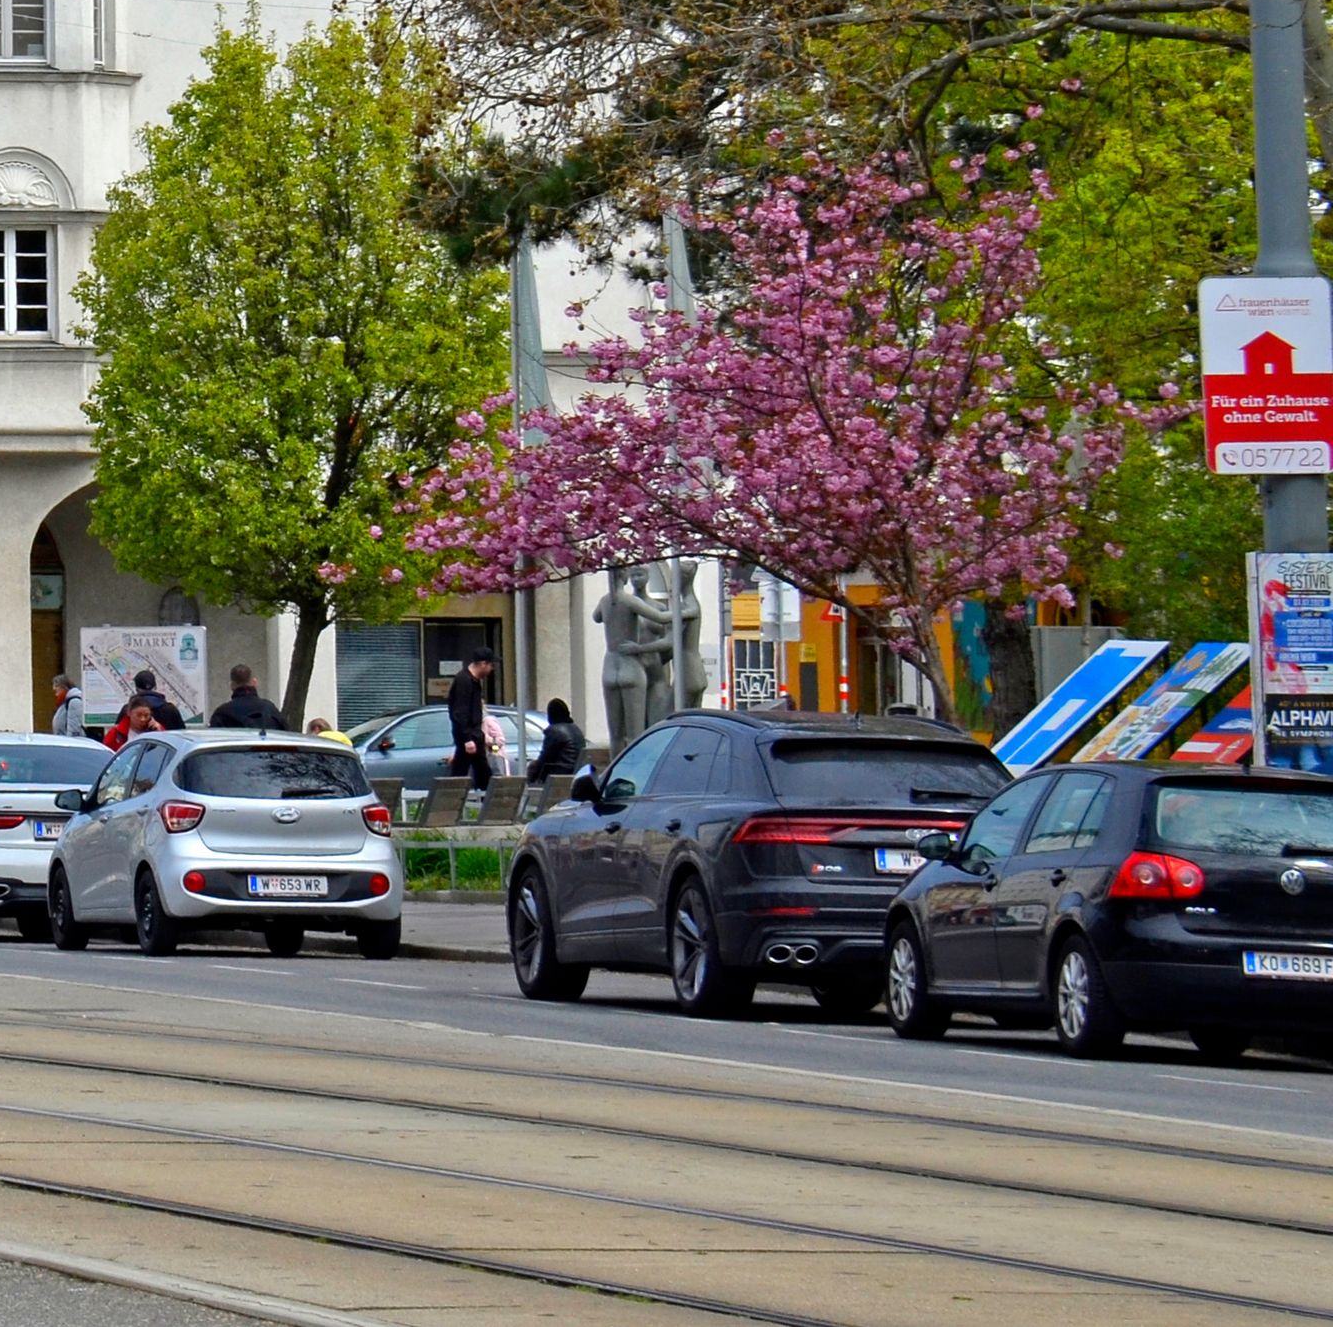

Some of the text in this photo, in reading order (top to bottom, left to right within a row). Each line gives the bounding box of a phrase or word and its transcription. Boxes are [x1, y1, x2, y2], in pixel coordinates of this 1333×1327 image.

[1247, 308, 1275, 316] wien
[1211, 395, 1329, 407] Für ein Zuhause
[1223, 410, 1318, 423] ohne Gewalt.
[1284, 574, 1331, 589] FESTIVAL
[133, 637, 177, 647] MARKT
[901, 852, 911, 866] W
[261, 878, 321, 892] W 653 WR
[1258, 955, 1278, 971] KO
[1292, 957, 1322, 973] 669
